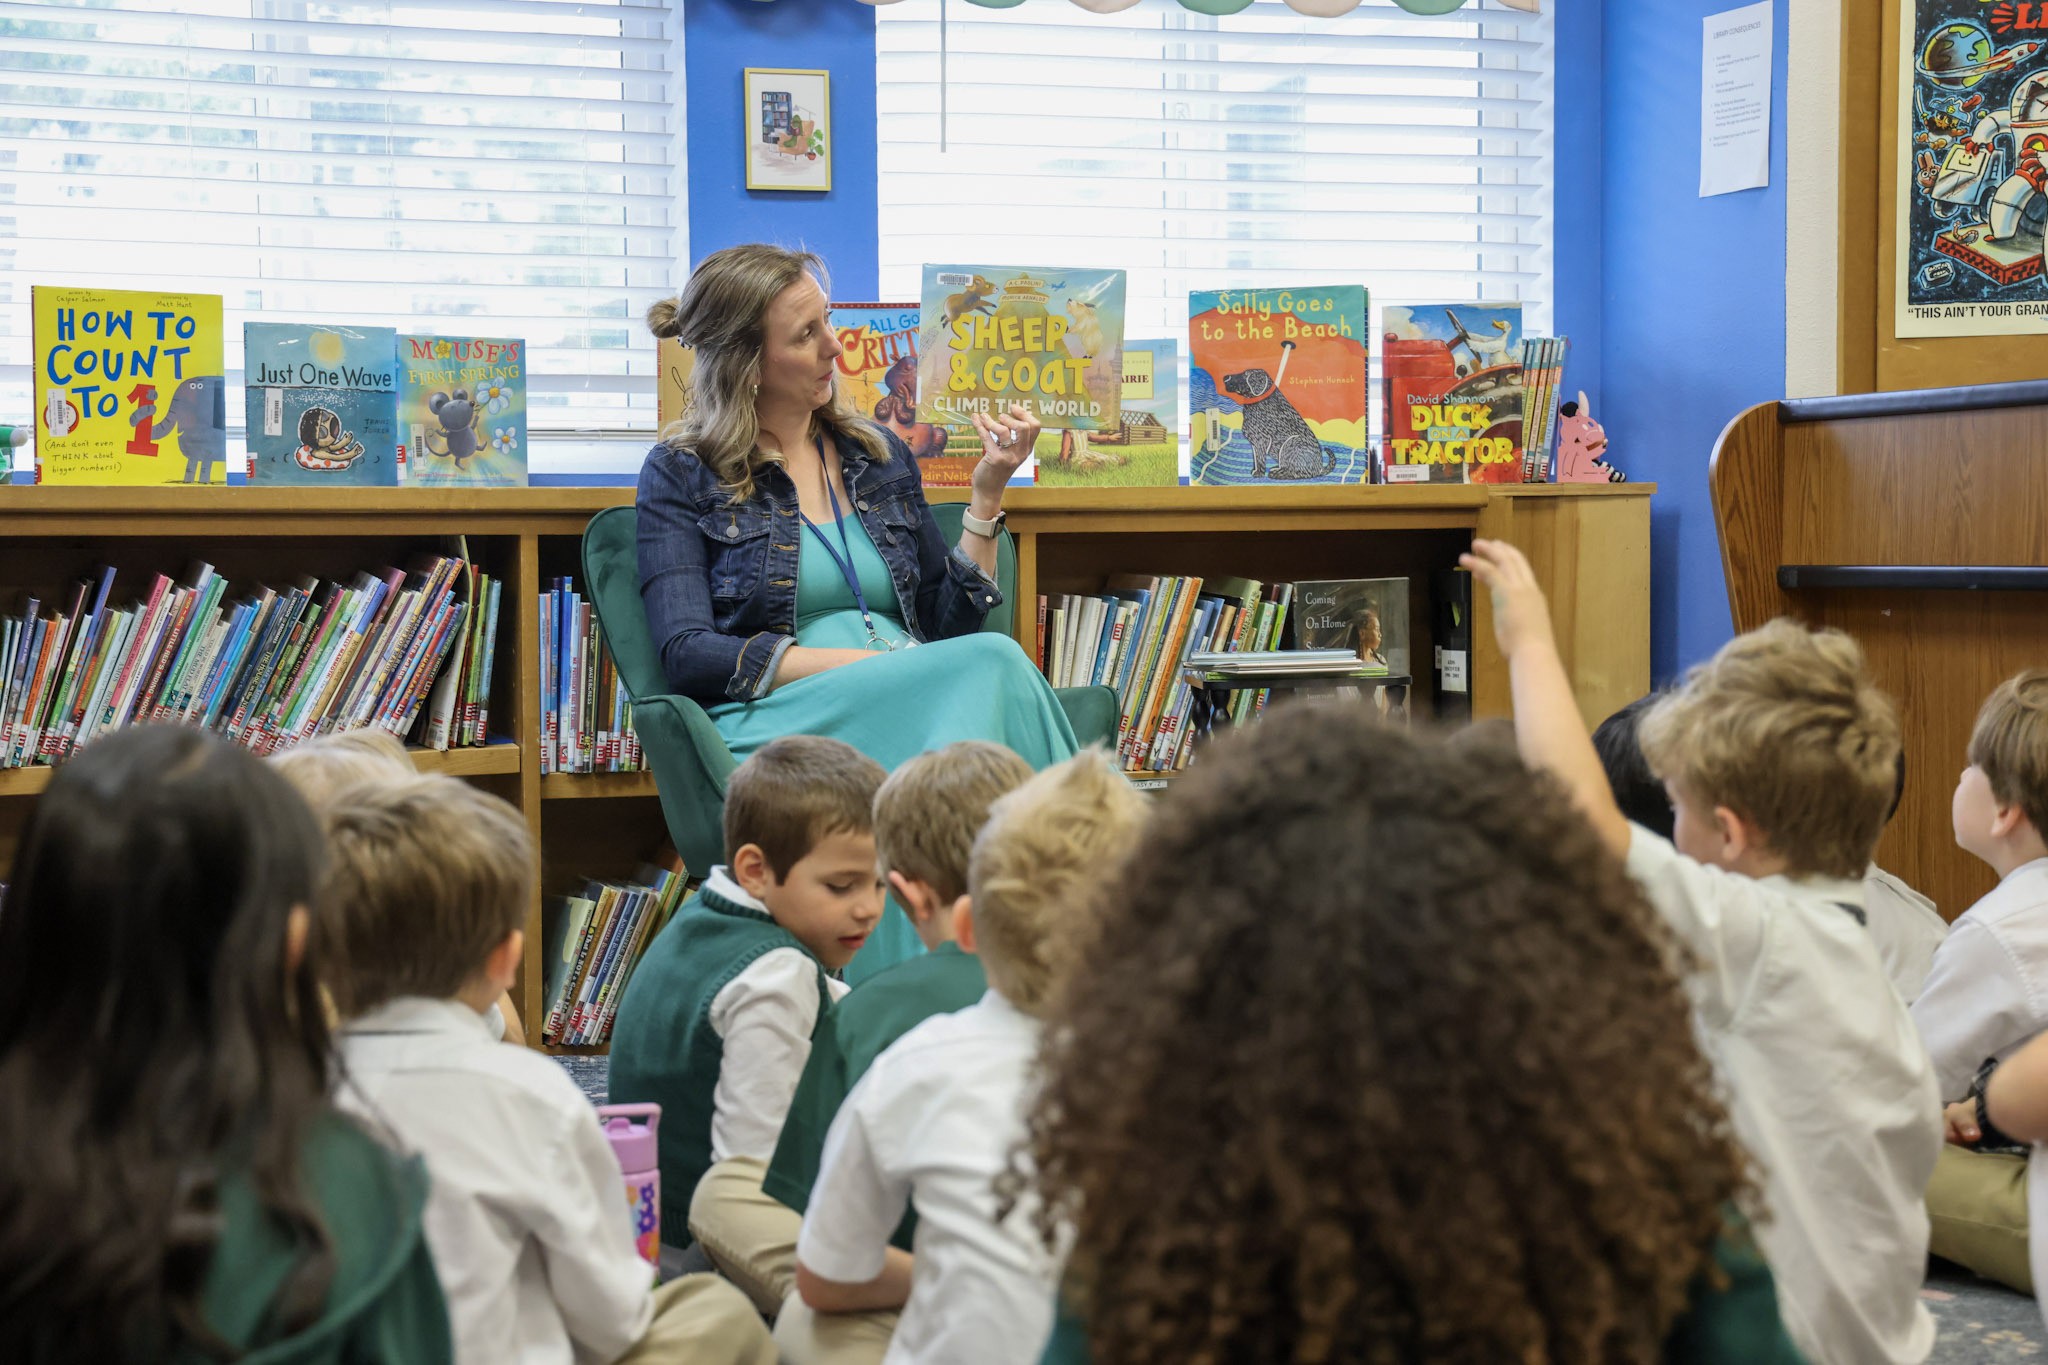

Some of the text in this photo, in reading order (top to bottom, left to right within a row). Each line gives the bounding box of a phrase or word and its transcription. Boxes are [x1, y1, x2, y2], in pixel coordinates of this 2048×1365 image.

[1216, 291, 1334, 322] Sally Goes
[1979, 305, 2012, 317] YOUR
[2016, 304, 2048, 316] GRAN
[57, 308, 196, 341] HOW TO
[868, 318, 896, 334] ALL
[949, 314, 1069, 353] SHEEP
[1201, 314, 1352, 341] to the Beach
[835, 325, 920, 376] CRITT
[47, 345, 190, 385] COUNT
[256, 362, 392, 387] Just One Wave
[949, 352, 977, 393] &
[408, 365, 520, 385] FIRST SPRING
[1289, 376, 1324, 389] Stephen
[933, 396, 1101, 418] CLIMB THE WORLD
[1407, 393, 1496, 405] David Shannon
[71, 385, 119, 418] TO
[126, 383, 159, 457] 1
[1410, 403, 1493, 432] DUCK
[1430, 429, 1468, 440] ON A
[52, 451, 114, 462] THINK about
[1391, 437, 1515, 466] TRACTOR
[52, 465, 76, 476] bigger
[1305, 592, 1336, 606] Coming
[28, 611, 36, 623] Three
[305, 615, 315, 628] Lost
[1305, 616, 1346, 630] On Home
[166, 627, 180, 649] LITTLE
[307, 623, 320, 642] Joseph
[342, 629, 354, 647] WALLY
[1125, 623, 1133, 637] DOG
[301, 642, 311, 654] Had
[389, 613, 424, 673] Detective LaRue
[396, 618, 431, 681] Dear Mrs. LaRue
[438, 623, 458, 657] THE SECRET
[158, 649, 170, 670] RED'S
[196, 645, 206, 658] THE
[262, 650, 272, 664] THE
[304, 642, 317, 661] Simon
[188, 658, 200, 675] MUD
[263, 665, 272, 677] Safe
[291, 659, 302, 675] Little
[382, 650, 398, 675] MAYOR
[1115, 658, 1124, 678] BOOKS
[148, 670, 161, 694] RIDING
[251, 663, 266, 685] HOUSE
[403, 653, 430, 700] FUNNY FARM
[244, 690, 253, 700] the
[582, 933, 592, 950] That
[573, 958, 584, 975] NOT
[565, 981, 576, 999] Good
